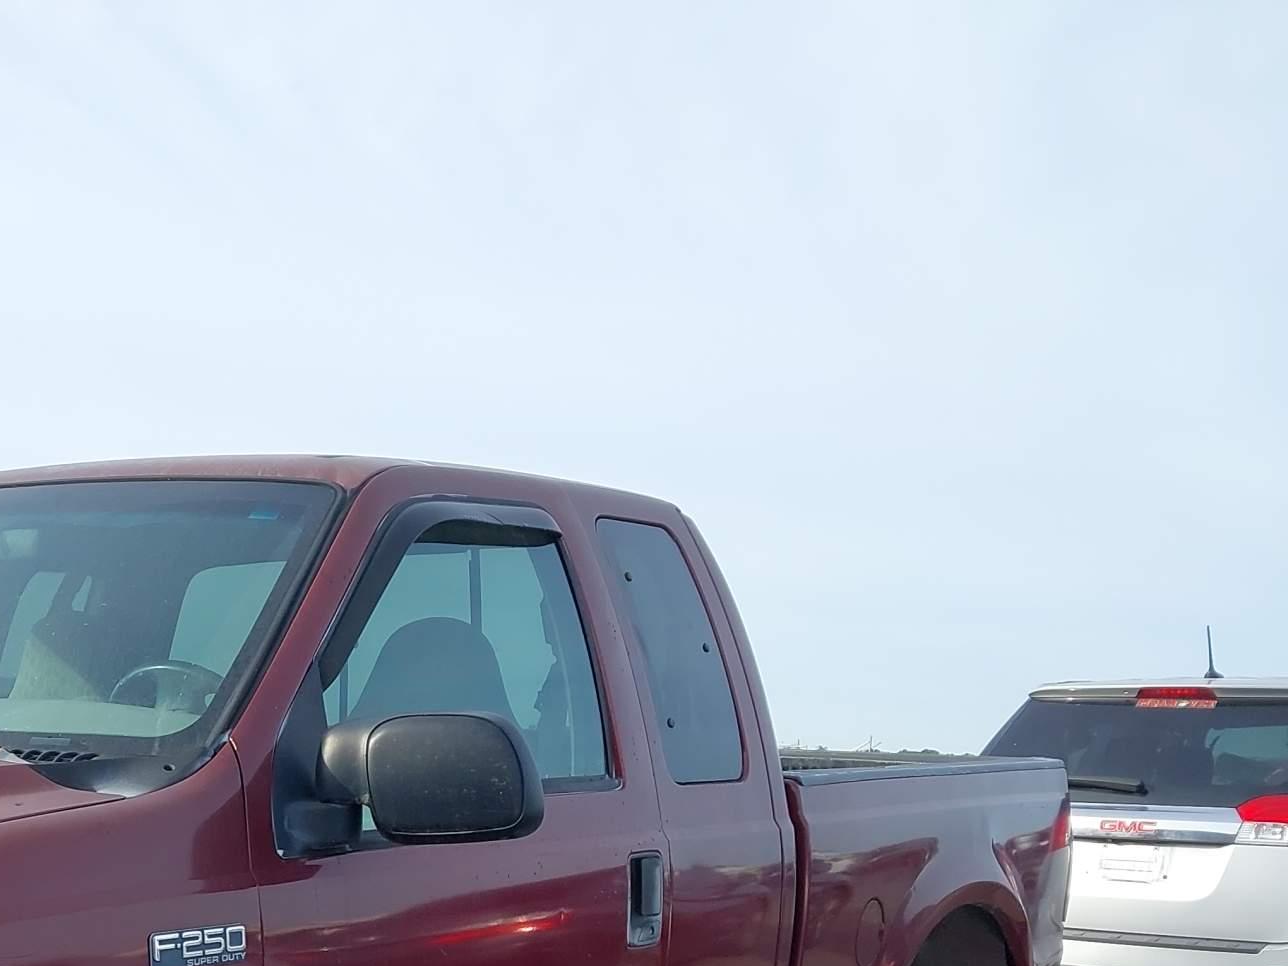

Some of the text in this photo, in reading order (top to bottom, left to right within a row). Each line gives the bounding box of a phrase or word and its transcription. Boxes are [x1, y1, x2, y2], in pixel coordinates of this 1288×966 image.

[1100, 819, 1158, 832] GMC
[186, 951, 247, 966] SUPER DUTY
